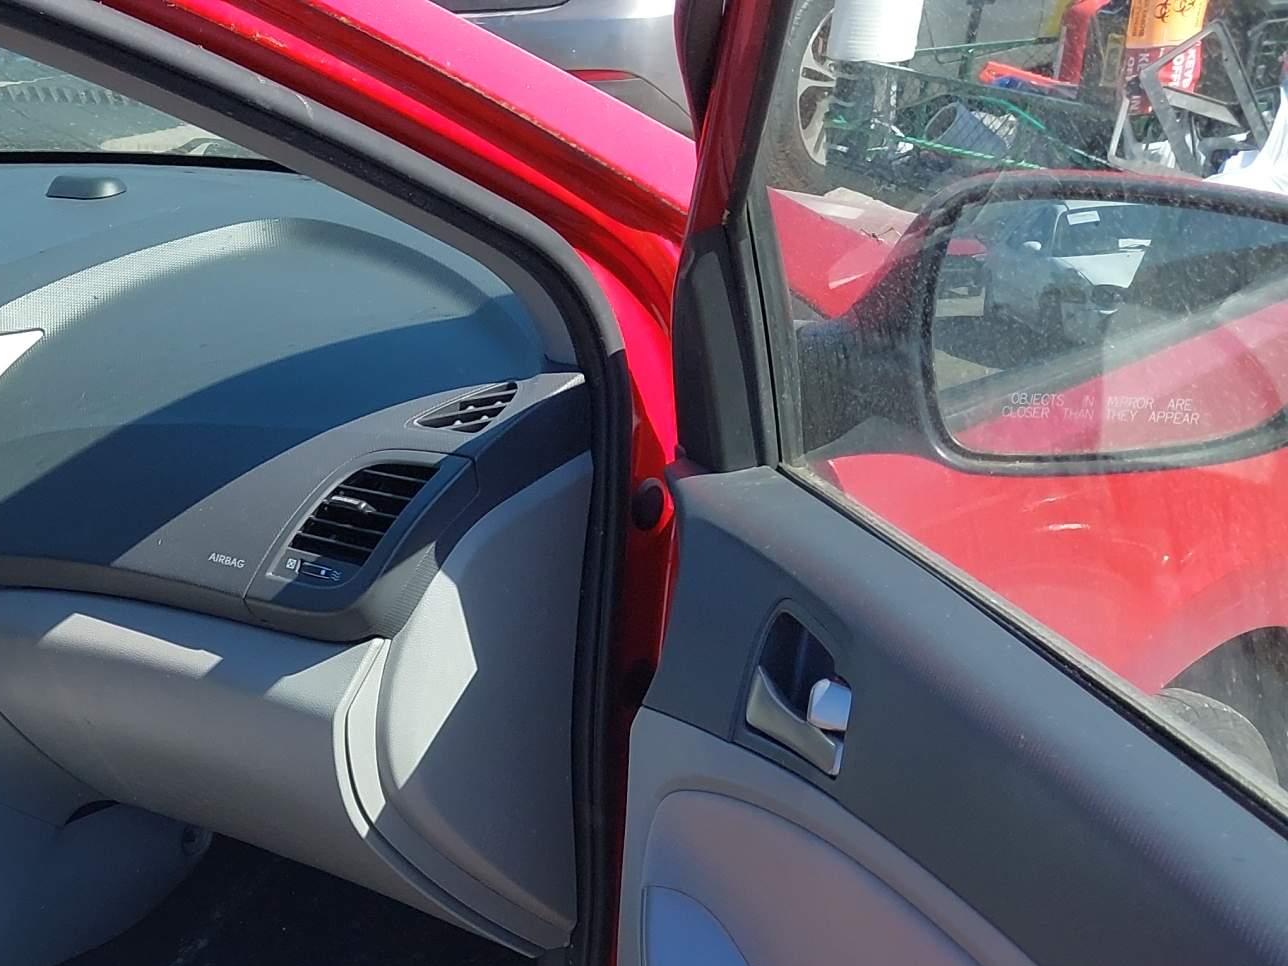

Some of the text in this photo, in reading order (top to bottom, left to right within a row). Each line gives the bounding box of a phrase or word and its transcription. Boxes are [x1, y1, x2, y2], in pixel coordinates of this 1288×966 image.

[1011, 392, 1192, 412] OBJECTS IN MIRROR ARE
[1002, 405, 1200, 425] CLOSER THAN THEY APPEAR
[208, 552, 246, 569] AIRBAG
